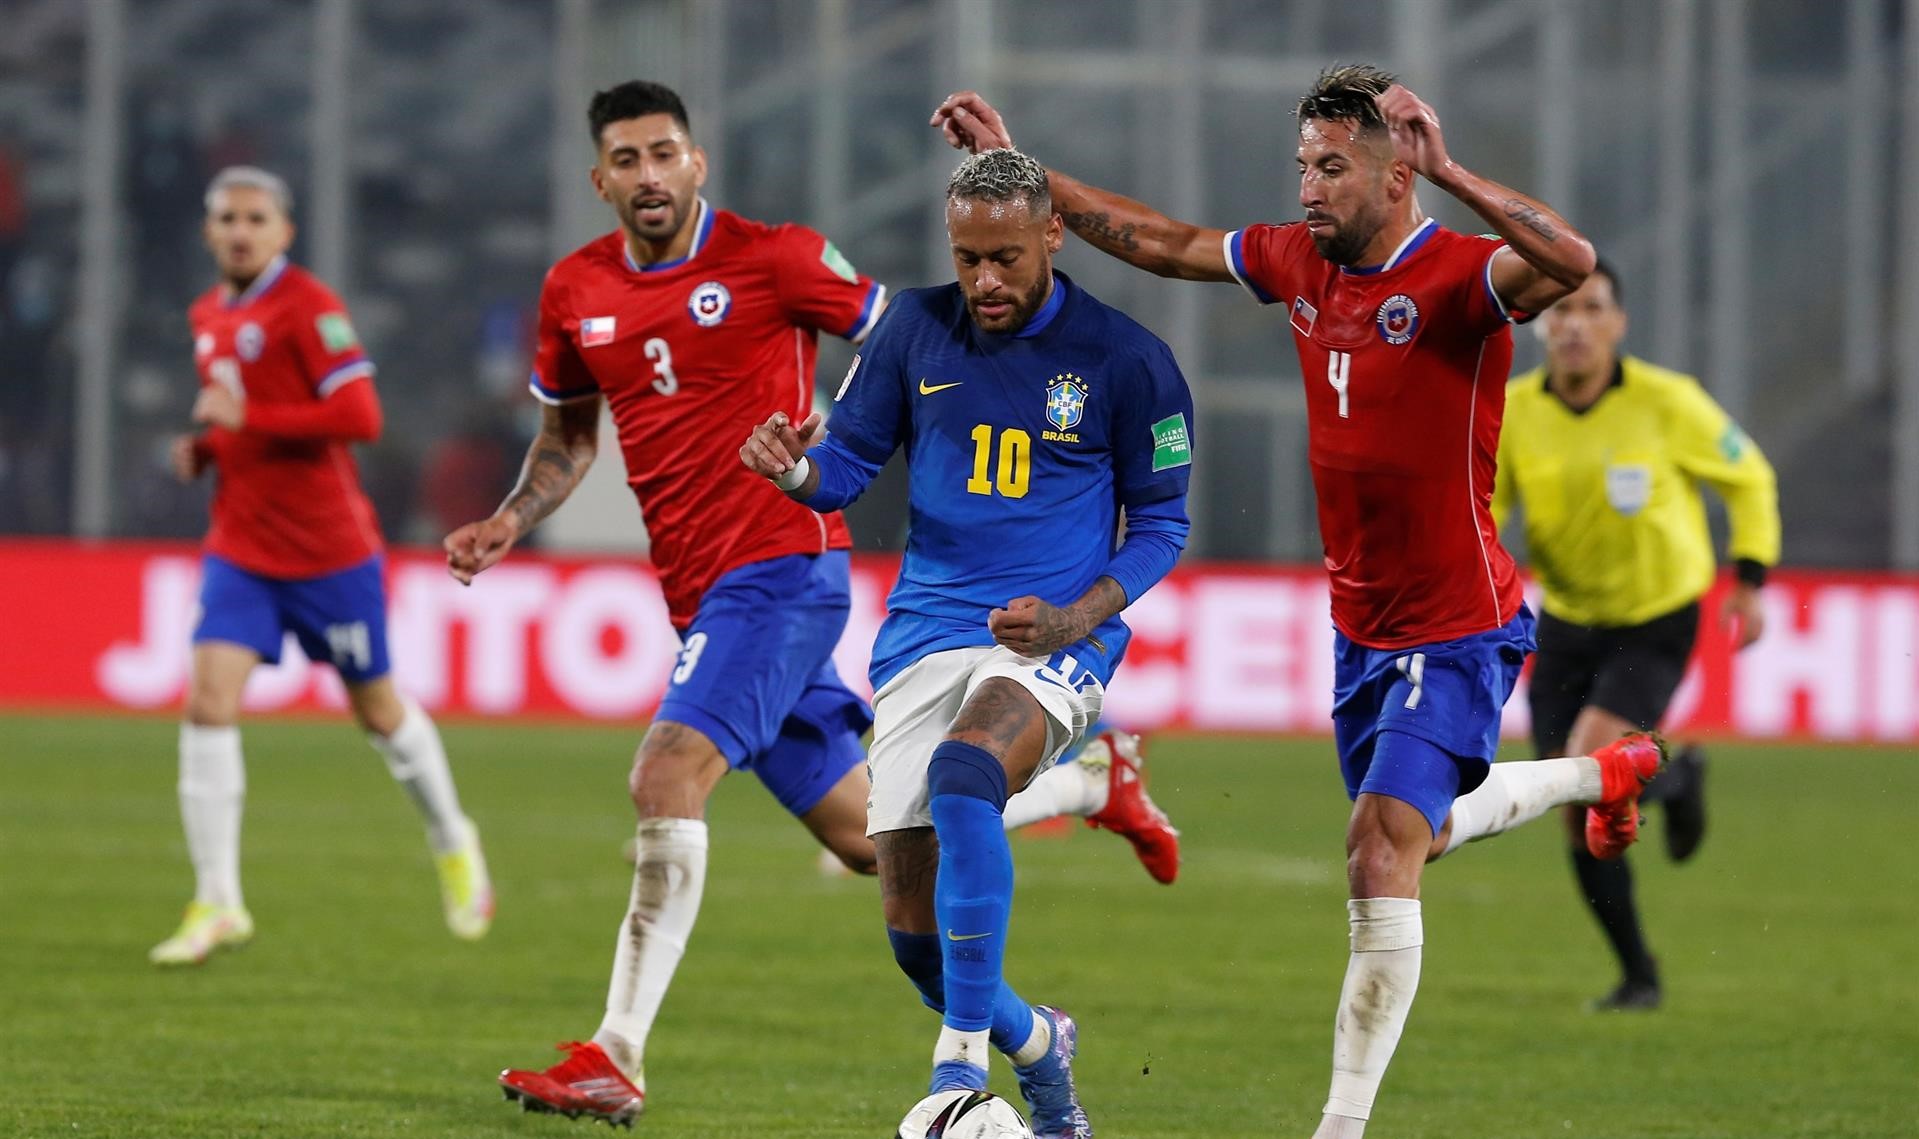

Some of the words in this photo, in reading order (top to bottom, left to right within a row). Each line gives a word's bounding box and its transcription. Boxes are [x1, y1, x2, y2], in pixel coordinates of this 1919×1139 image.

[644, 337, 678, 396] 3
[1327, 350, 1351, 418] 4
[1058, 400, 1073, 408] CBF
[967, 423, 1031, 499] 10
[1042, 430, 1081, 443] BRASIL
[673, 632, 708, 685] 3
[1396, 652, 1426, 710] 4
